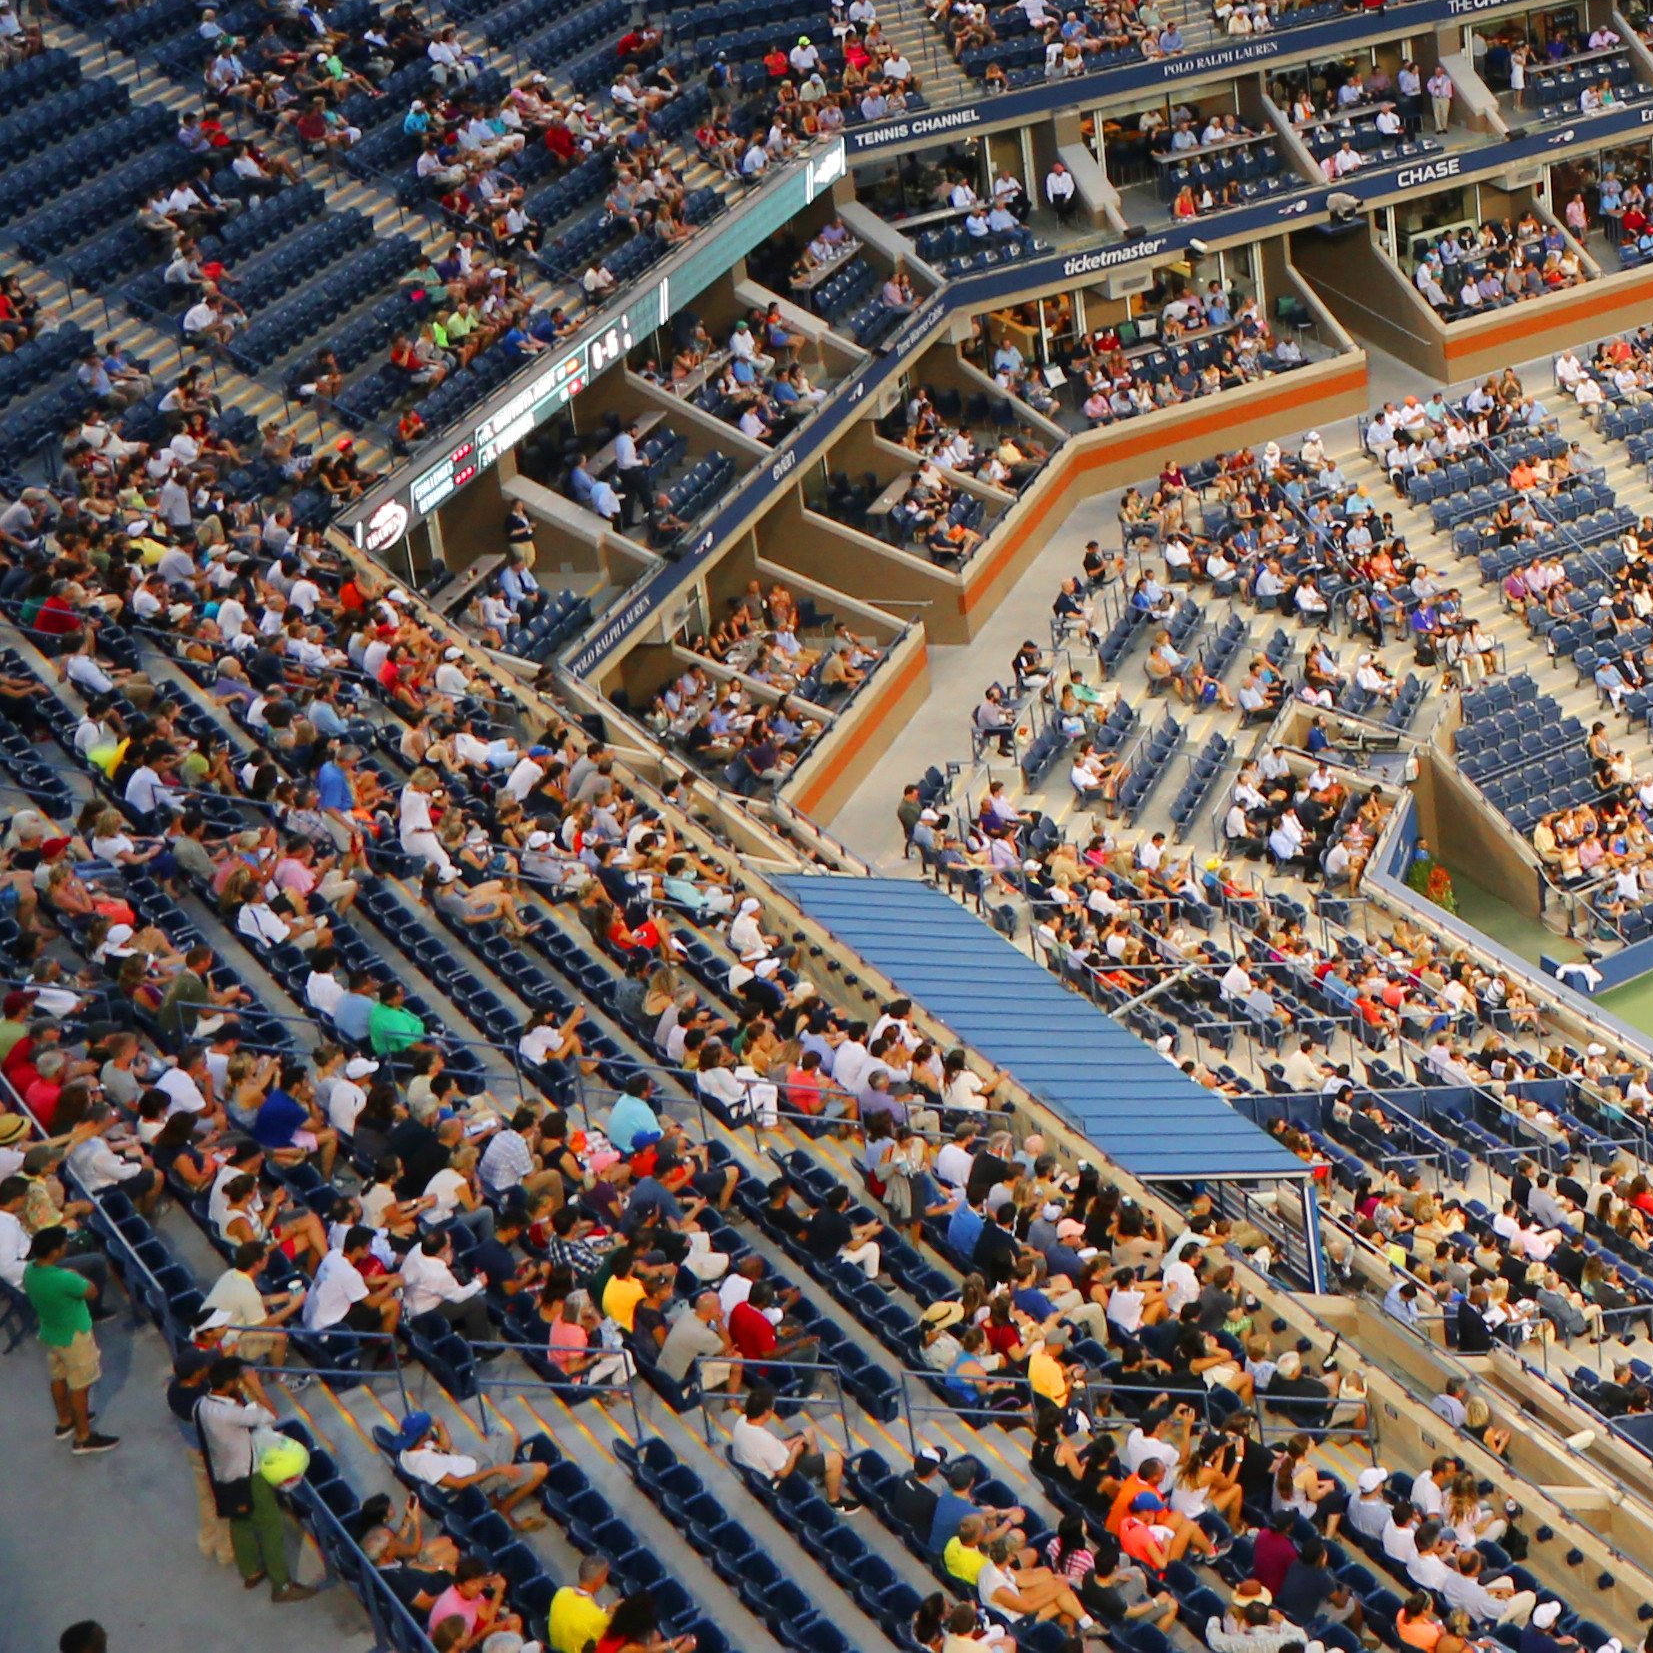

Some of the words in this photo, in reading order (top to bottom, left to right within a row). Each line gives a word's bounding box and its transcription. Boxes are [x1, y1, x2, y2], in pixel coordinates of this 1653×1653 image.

[1163, 61, 1193, 77] POLO
[1196, 51, 1233, 71] RALPH
[1234, 41, 1279, 63] LAUREN
[855, 124, 909, 147] TENNIS
[911, 108, 980, 135] CHANNEL
[1397, 157, 1461, 188] CHASE
[1063, 238, 1162, 277] ticketmaster
[772, 450, 796, 482] evian
